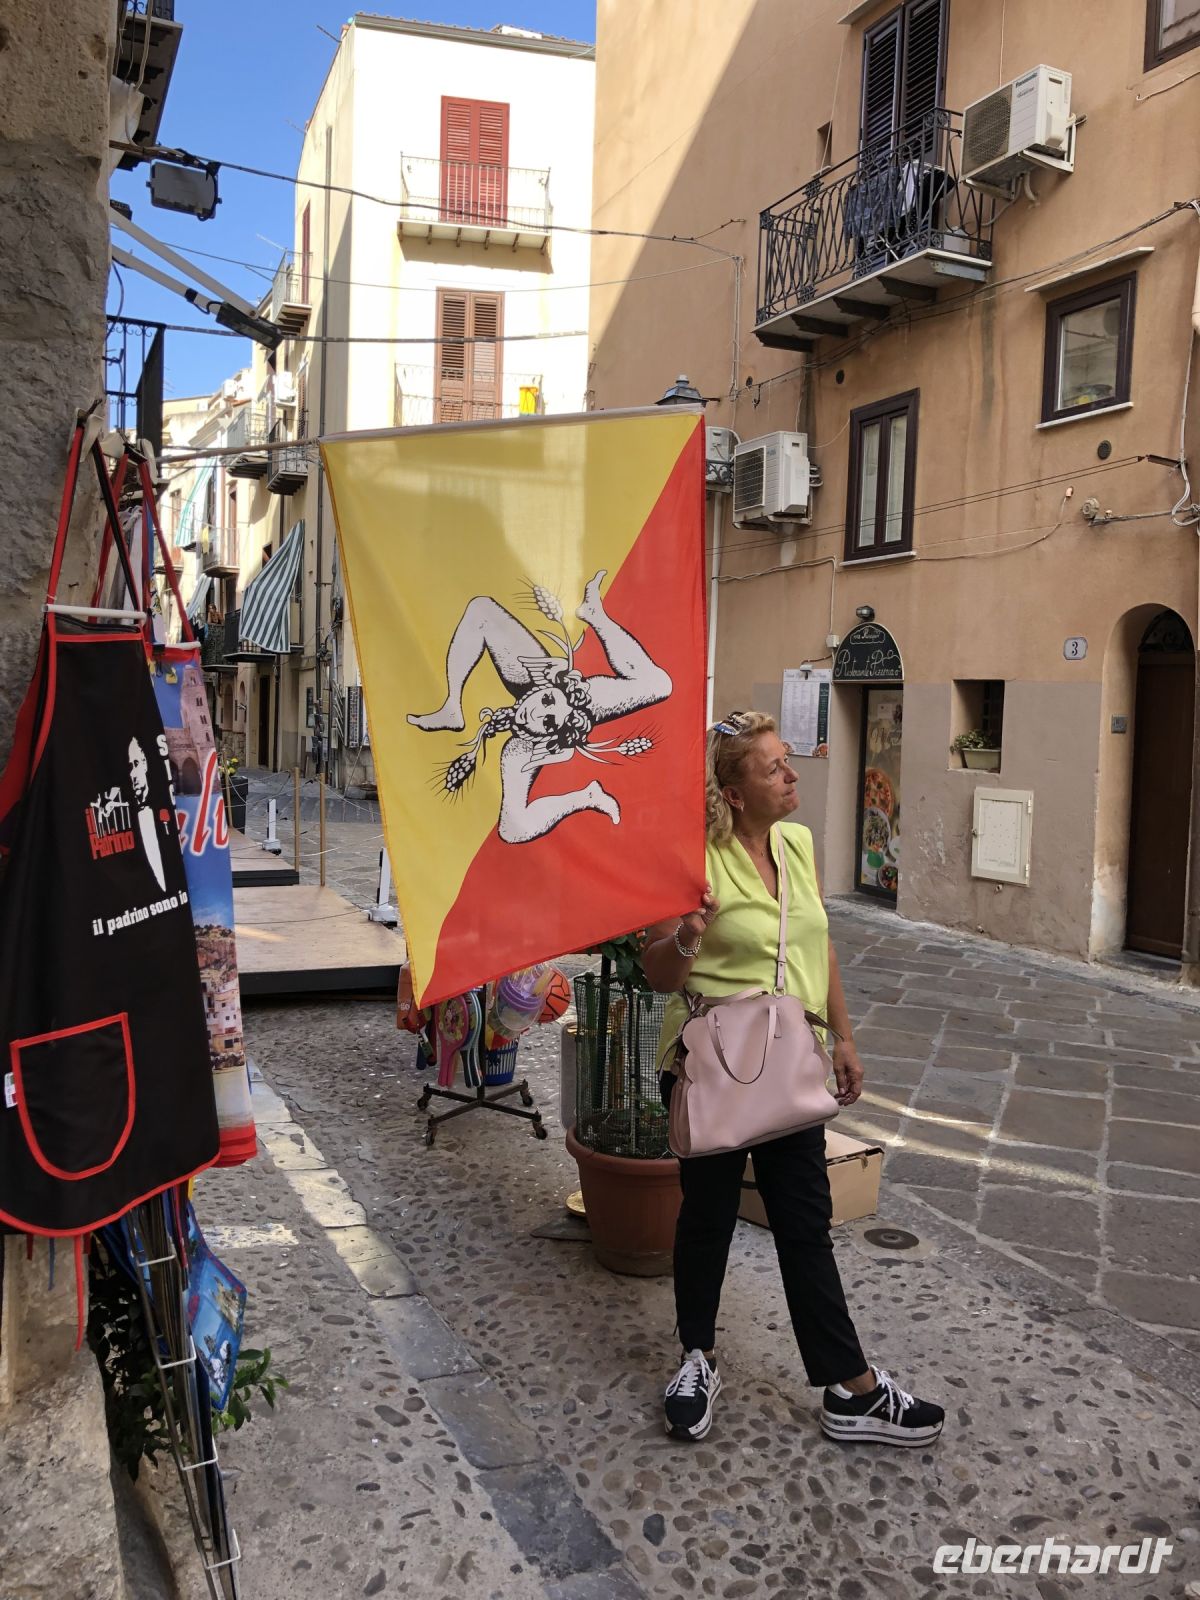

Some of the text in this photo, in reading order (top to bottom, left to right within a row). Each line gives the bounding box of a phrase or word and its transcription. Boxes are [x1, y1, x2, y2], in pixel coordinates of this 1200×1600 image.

[1071, 641, 1079, 656] 3
[92, 890, 188, 936] il padrino sono io
